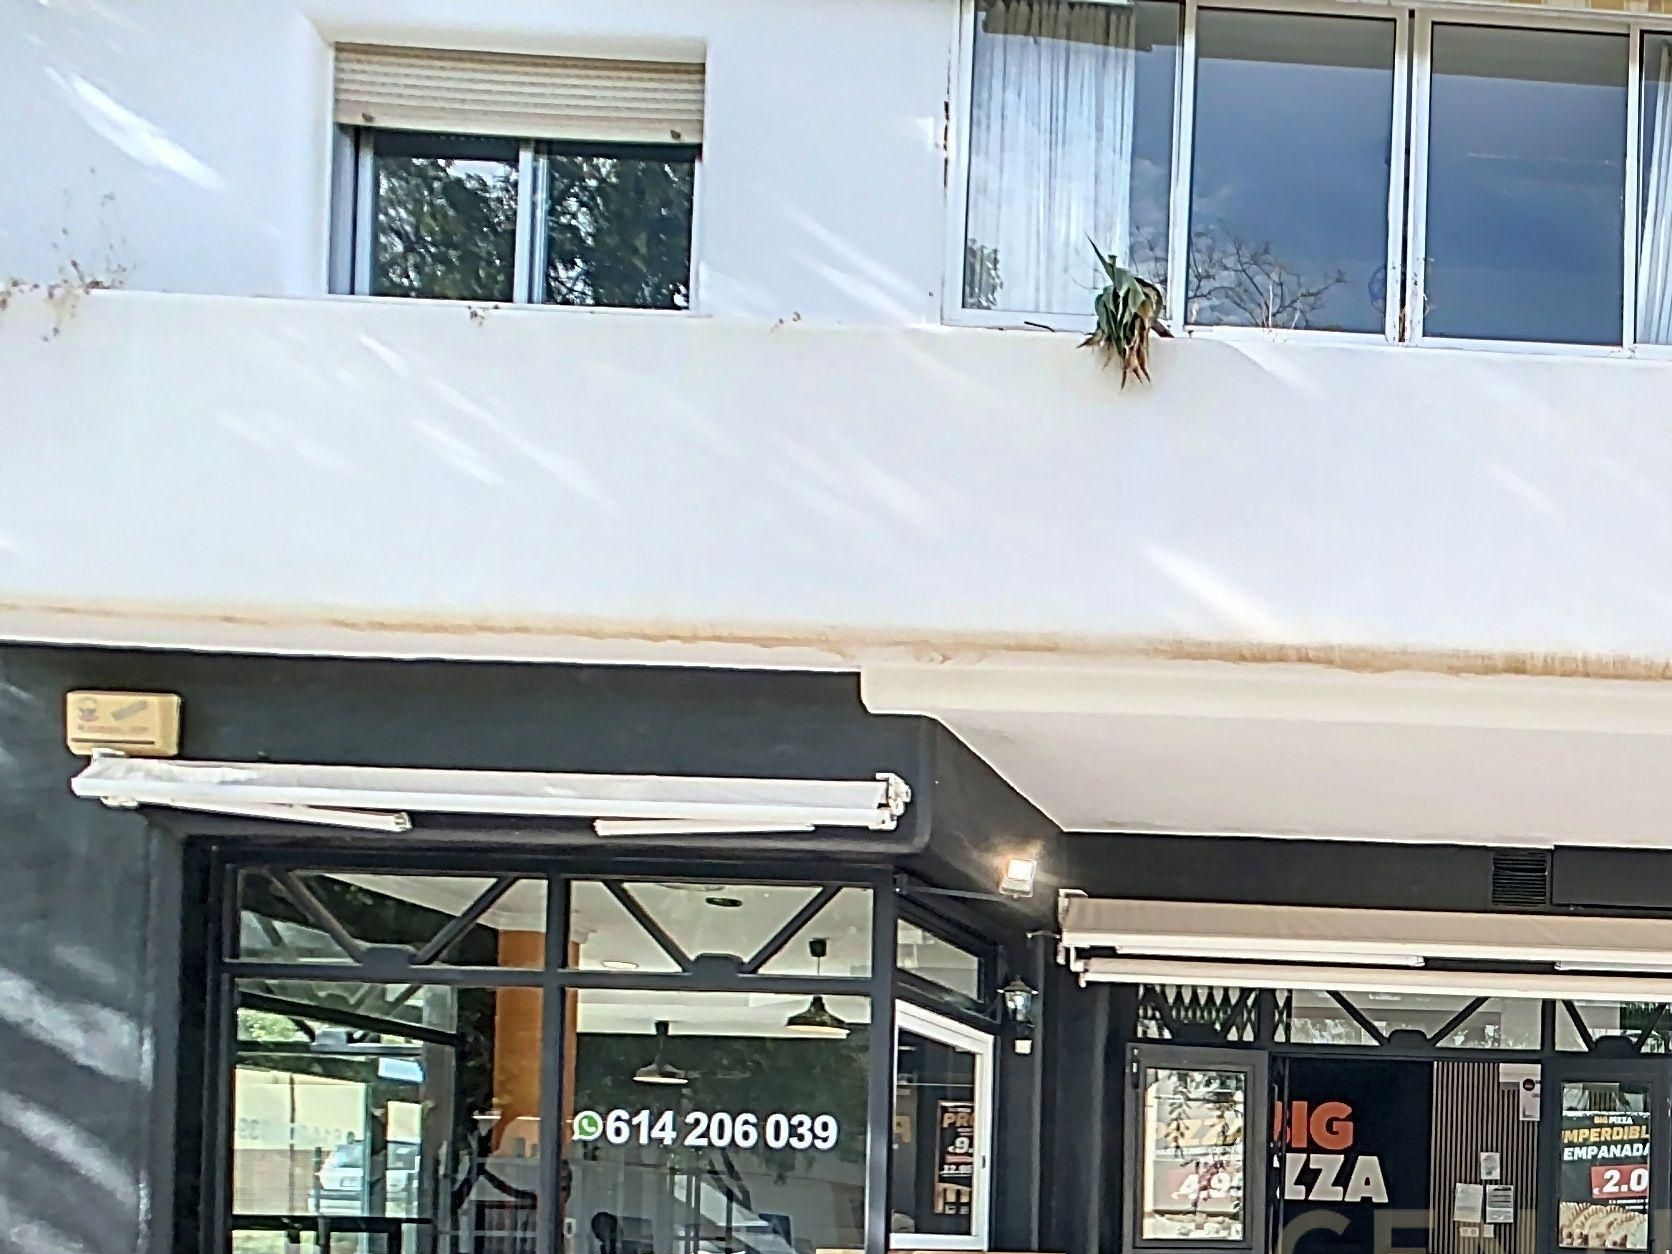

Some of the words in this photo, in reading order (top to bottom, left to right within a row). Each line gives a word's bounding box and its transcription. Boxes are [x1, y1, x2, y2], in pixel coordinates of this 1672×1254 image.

[605, 1109, 677, 1145] 614
[683, 1111, 759, 1149] 206
[765, 1113, 838, 1150] 039
[1273, 1152, 1388, 1203] ZZA
